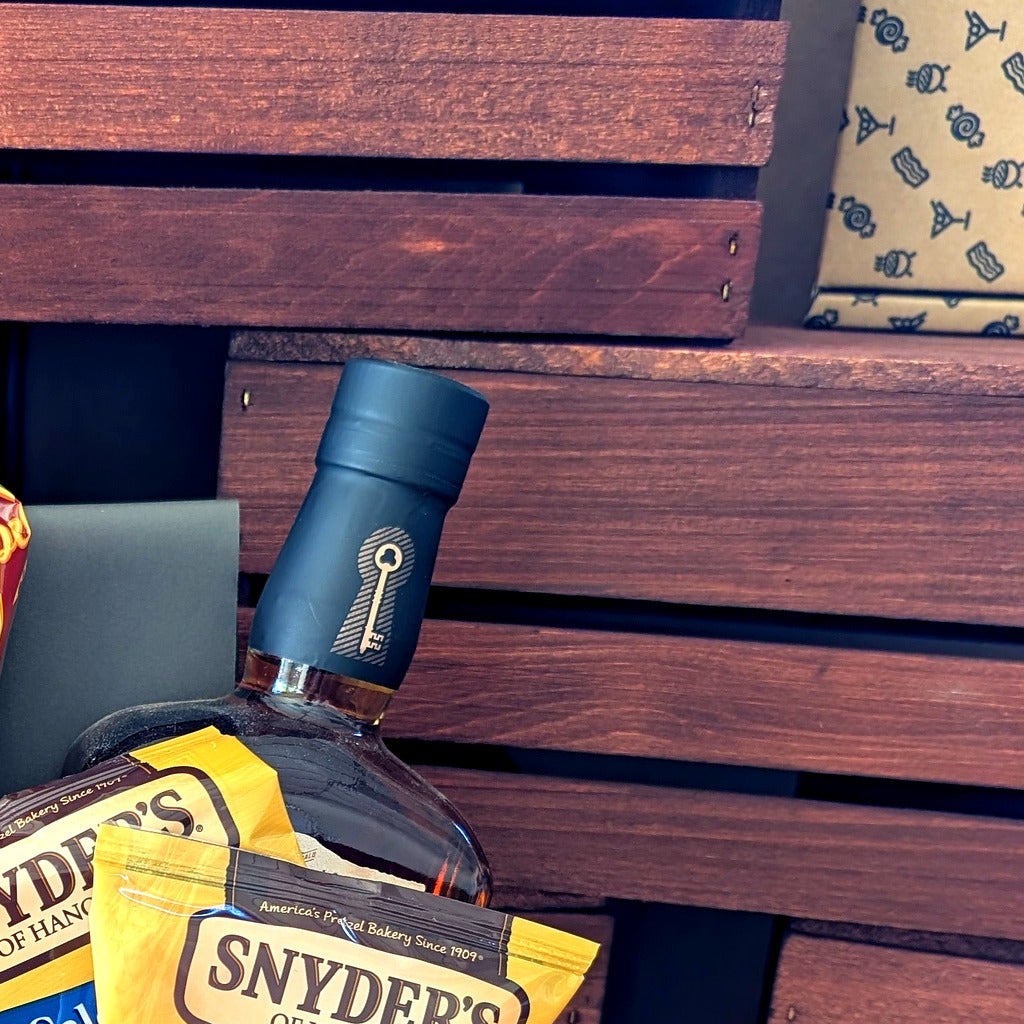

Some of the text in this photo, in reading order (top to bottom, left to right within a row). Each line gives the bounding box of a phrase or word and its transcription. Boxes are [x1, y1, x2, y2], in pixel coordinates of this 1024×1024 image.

[14, 802, 59, 830] Bakery
[59, 788, 94, 806] Since
[258, 901, 478, 961] America's Pretzel Bakery Since 1909
